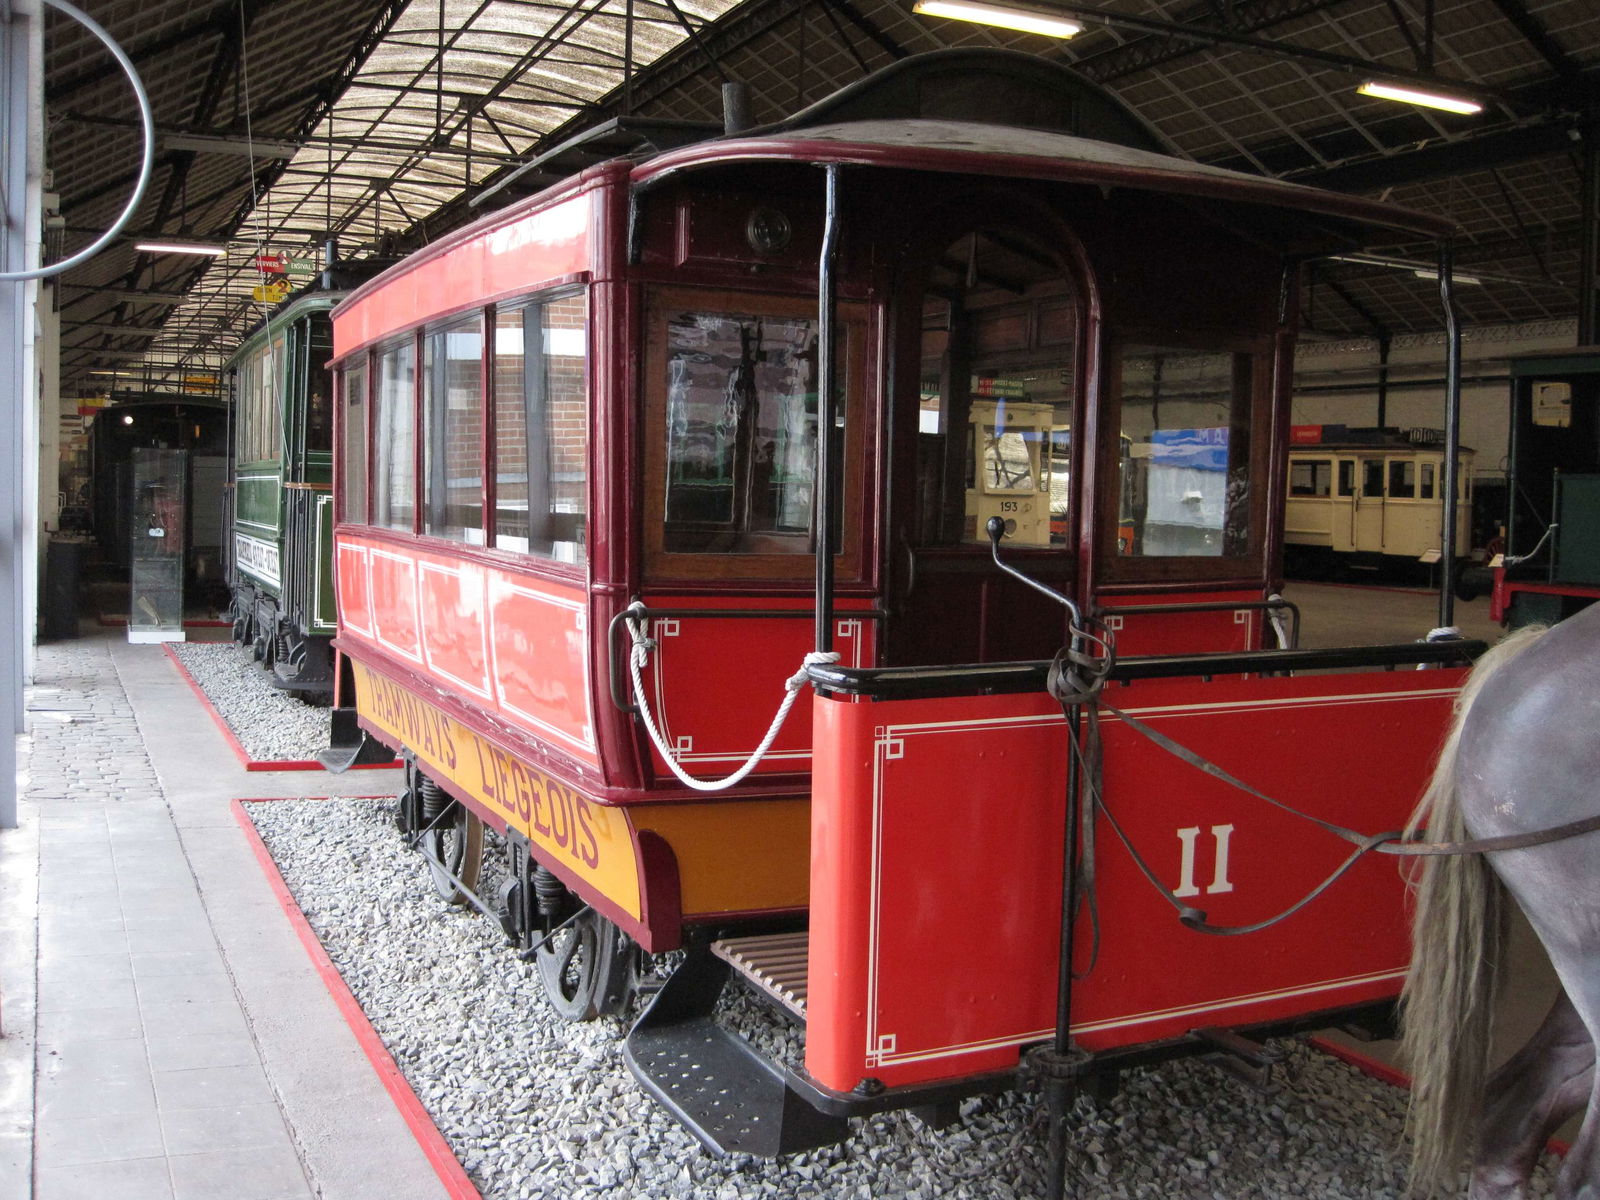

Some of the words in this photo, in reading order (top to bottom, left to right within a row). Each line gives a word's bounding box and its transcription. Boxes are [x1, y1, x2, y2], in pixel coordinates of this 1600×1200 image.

[290, 262, 312, 270] ENSIVAL
[1000, 501, 1018, 512] 193
[367, 666, 457, 771] TRAMWAYS
[473, 735, 599, 870] LIEGEOIS
